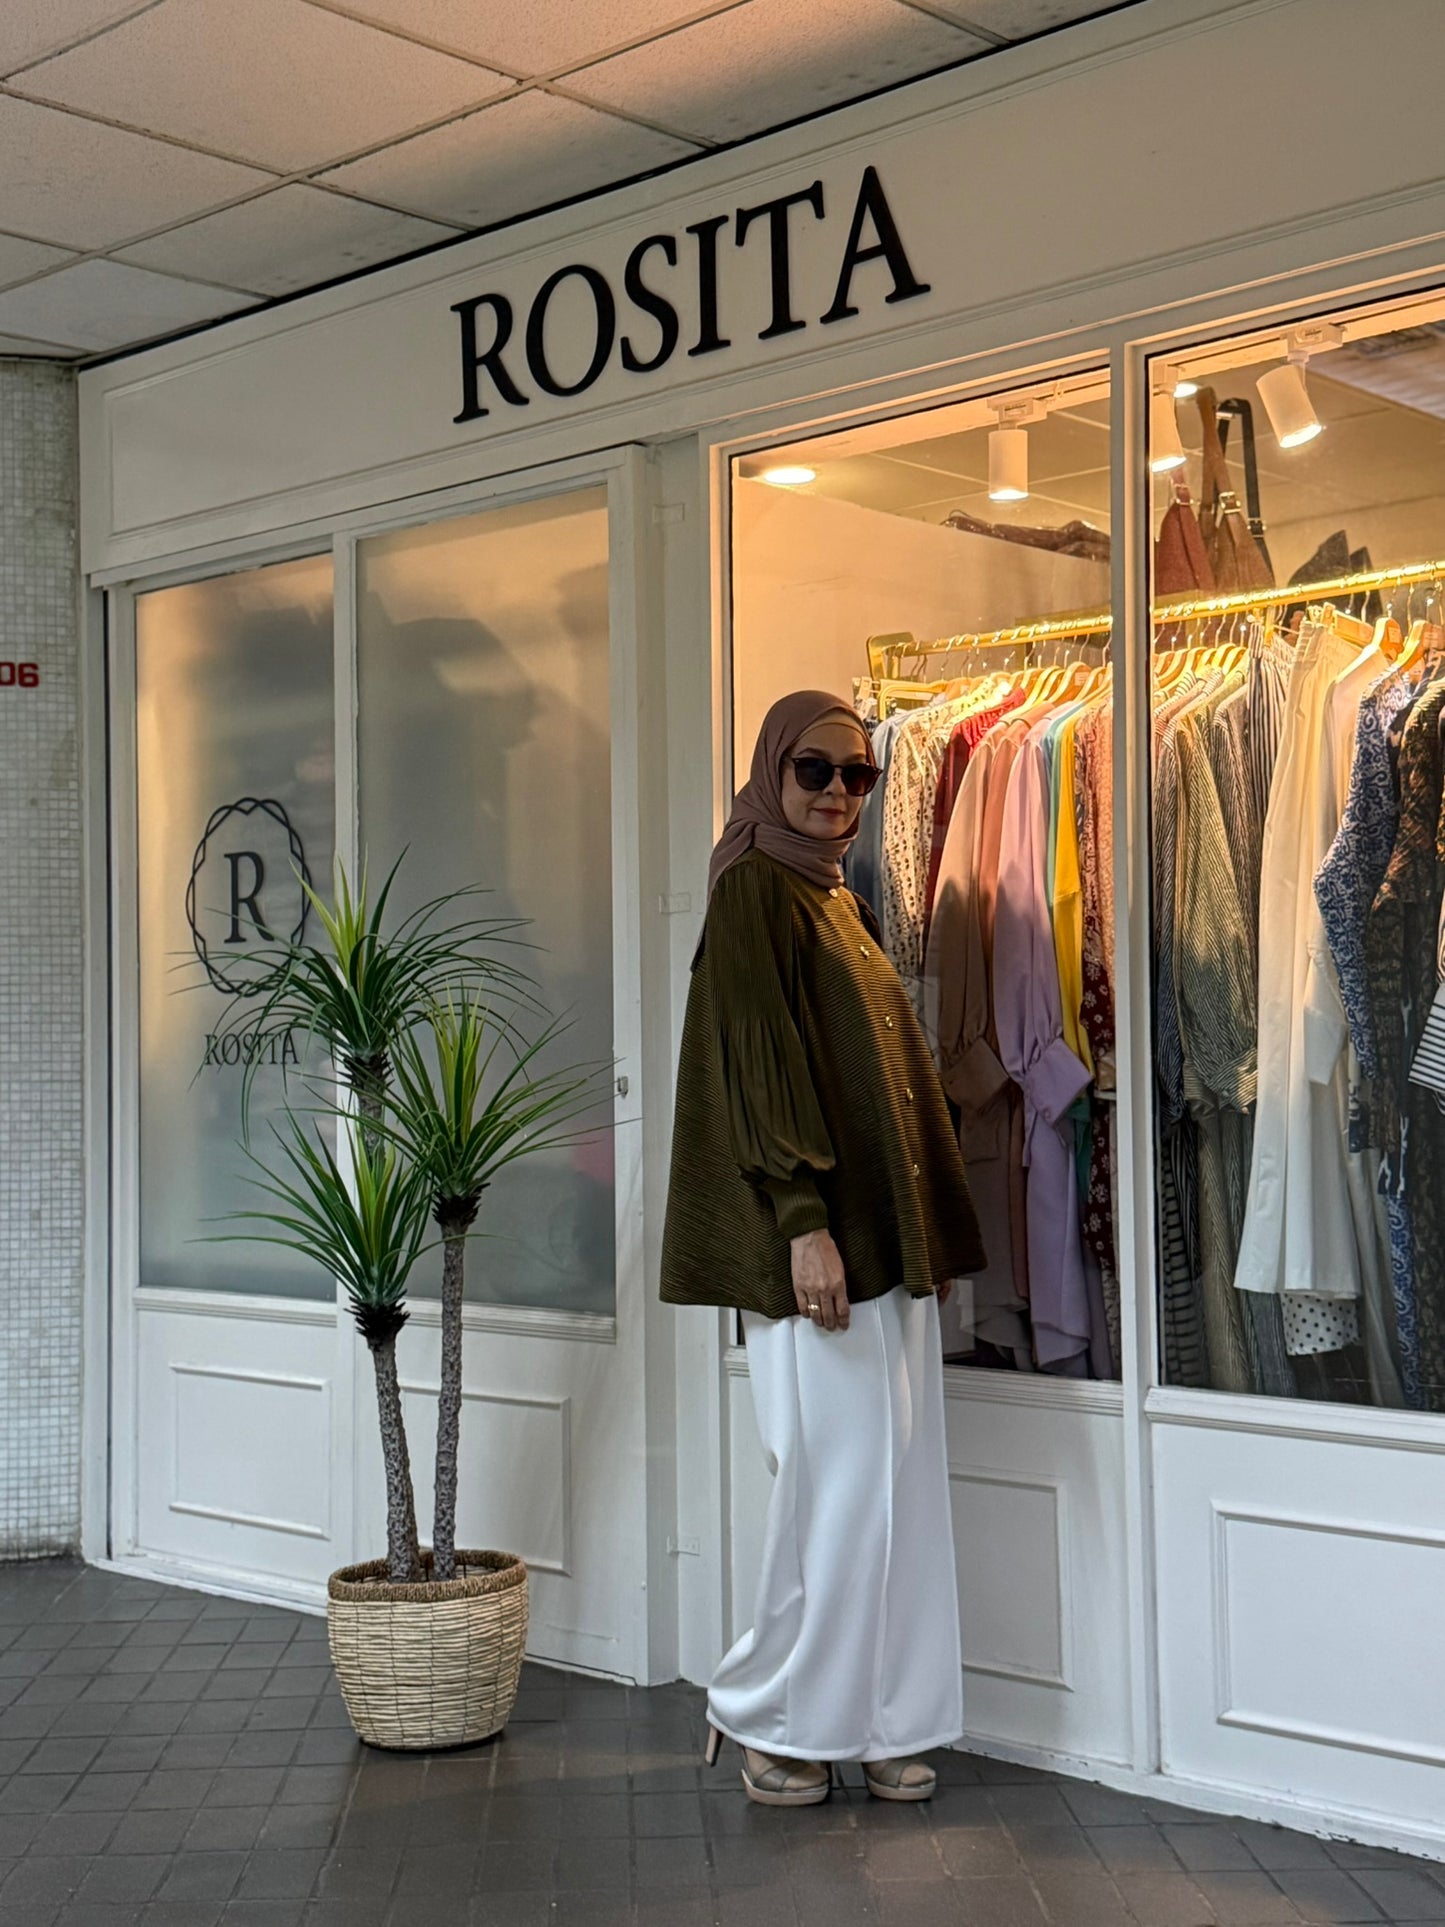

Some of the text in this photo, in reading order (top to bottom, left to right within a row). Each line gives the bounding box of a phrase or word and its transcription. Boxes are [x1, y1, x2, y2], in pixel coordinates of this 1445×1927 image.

[450, 165, 931, 424] ROSITA
[0, 662, 39, 688] 06
[223, 851, 275, 944] R
[204, 1027, 300, 1066] ROSITA
